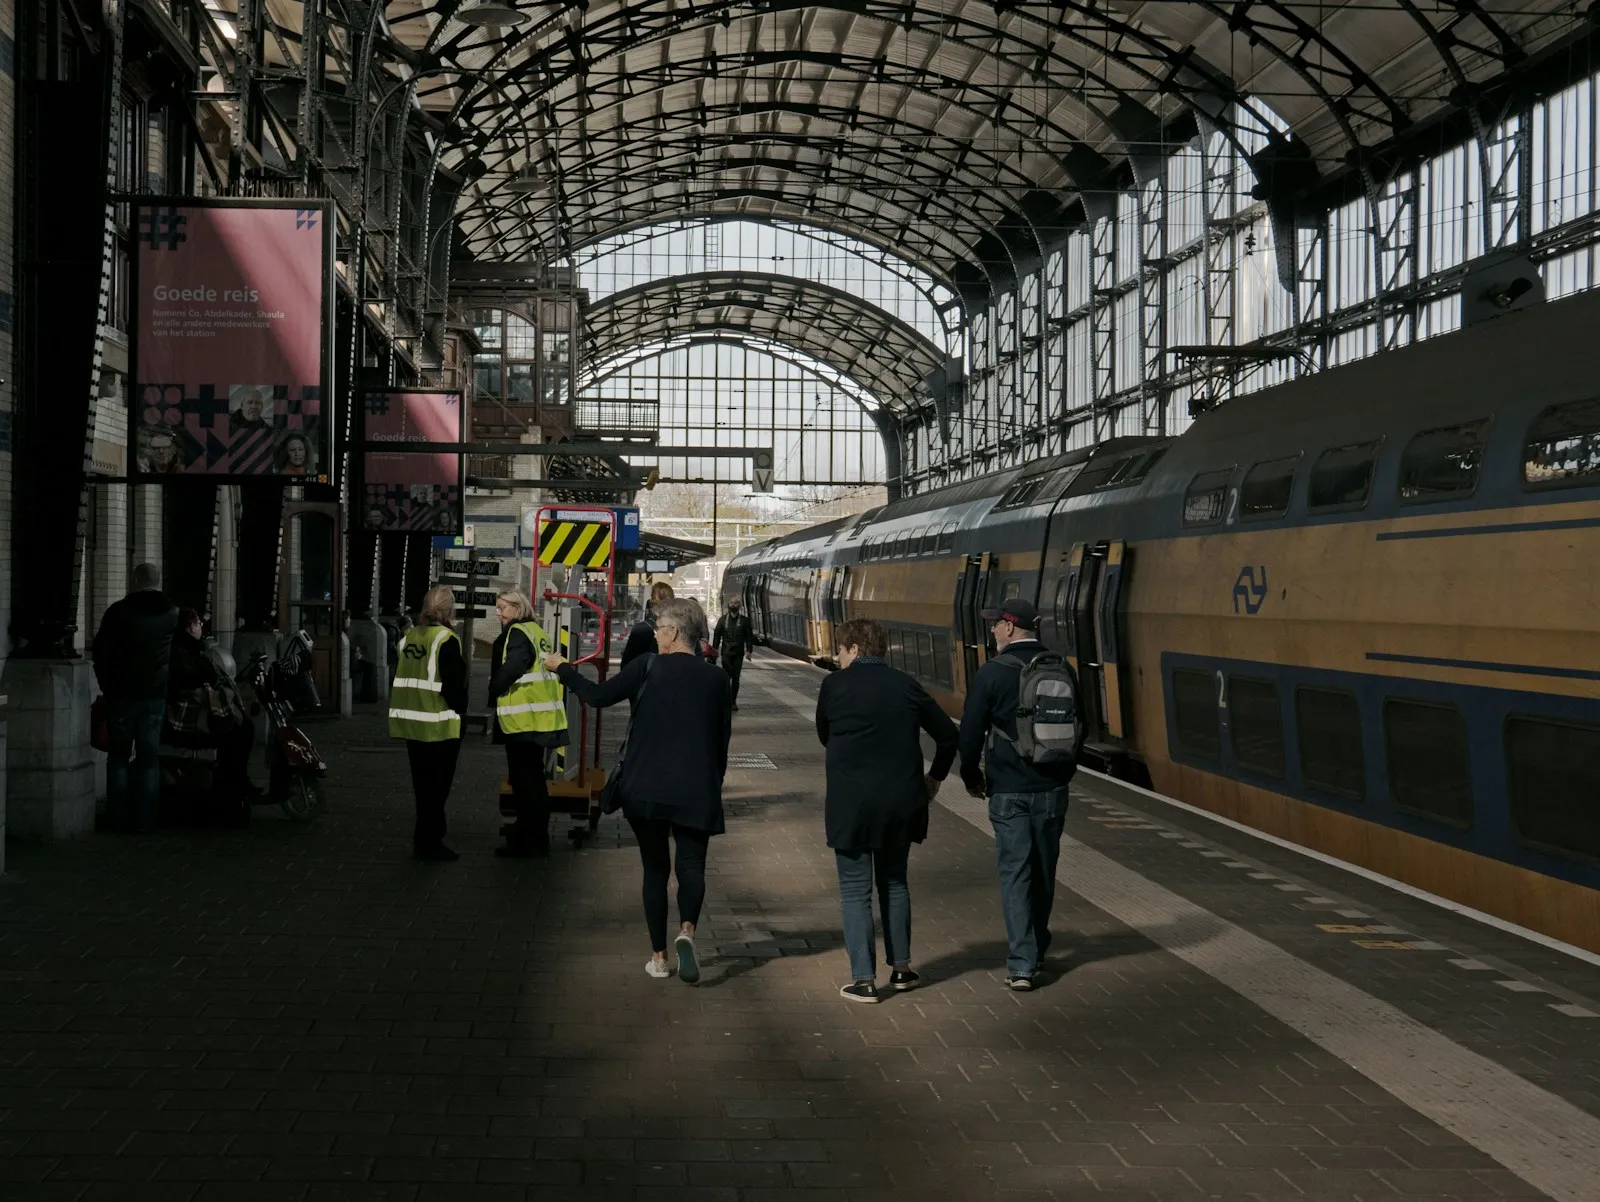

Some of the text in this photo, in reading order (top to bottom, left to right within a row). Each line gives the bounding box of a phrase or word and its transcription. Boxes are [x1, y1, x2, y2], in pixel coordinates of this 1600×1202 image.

[153, 285, 259, 303] Goede reis
[152, 309, 186, 317] Namens
[256, 310, 285, 319] Shaula
[165, 319, 181, 327] alle
[183, 319, 212, 328] andere
[214, 319, 271, 329] medewerkers
[152, 329, 216, 337] van het station
[371, 432, 427, 442] Goede reis
[756, 470, 771, 491] V
[1226, 487, 1238, 525] 2
[1216, 669, 1227, 709] 2
